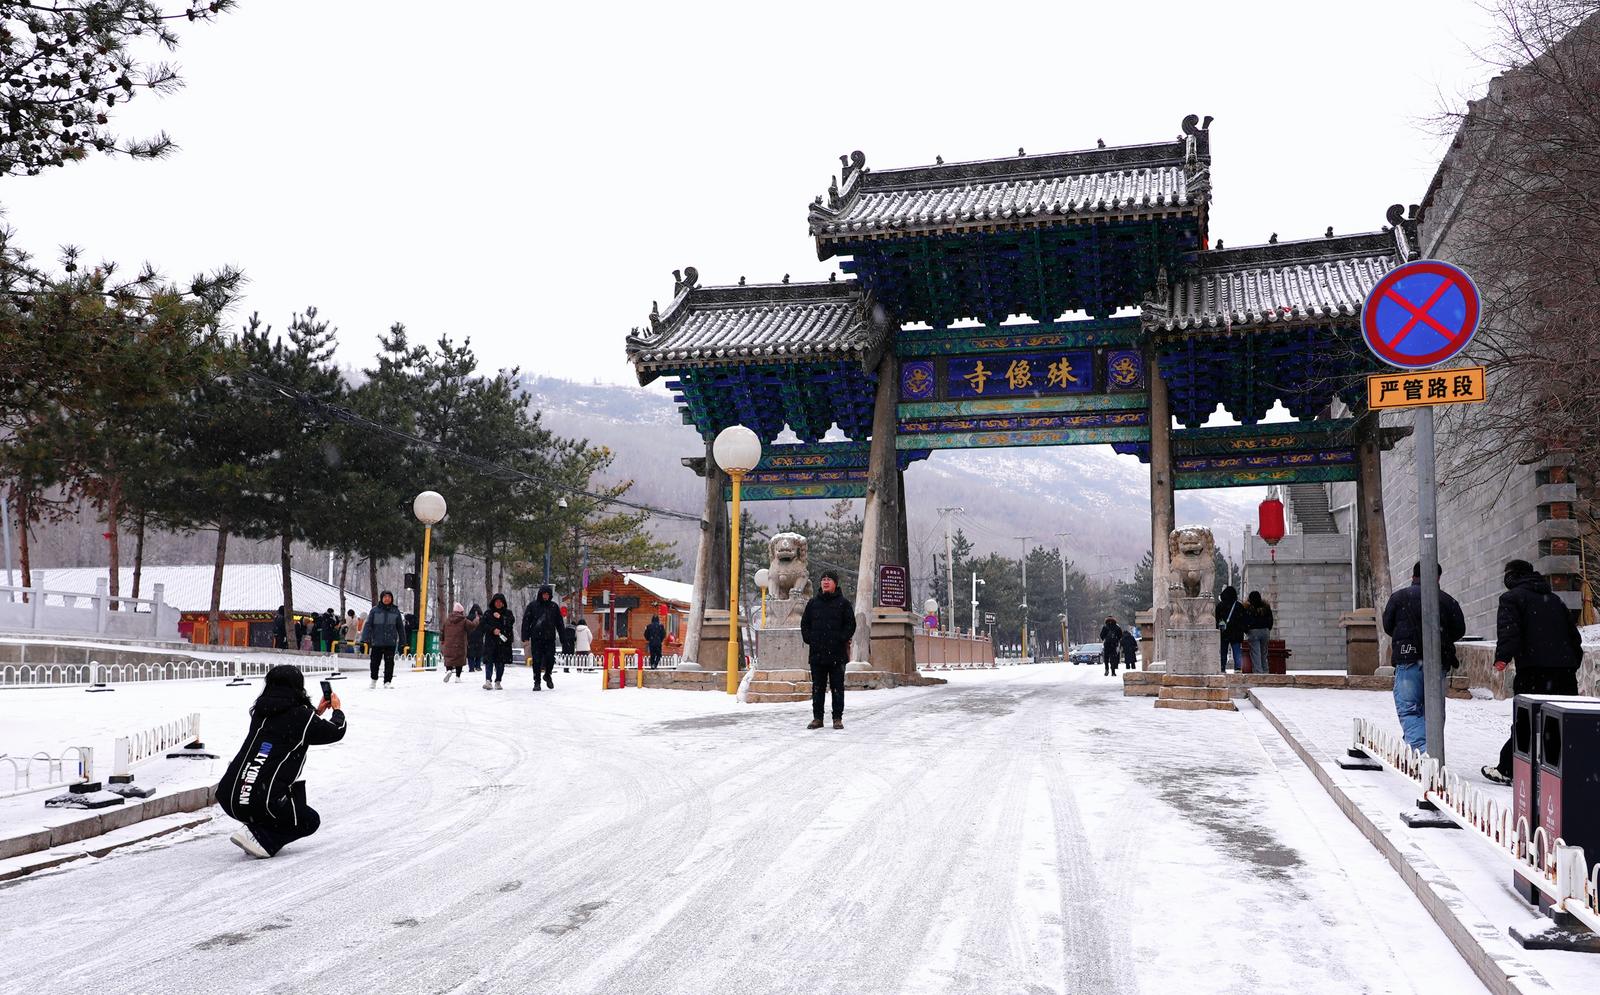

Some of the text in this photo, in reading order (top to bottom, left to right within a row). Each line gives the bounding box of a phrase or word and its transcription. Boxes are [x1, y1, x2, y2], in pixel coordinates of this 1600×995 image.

[1379, 375, 1473, 402] 严管路段
[253, 741, 273, 765] ONLY
[244, 765, 262, 784] YOU
[239, 785, 253, 805] CAN
